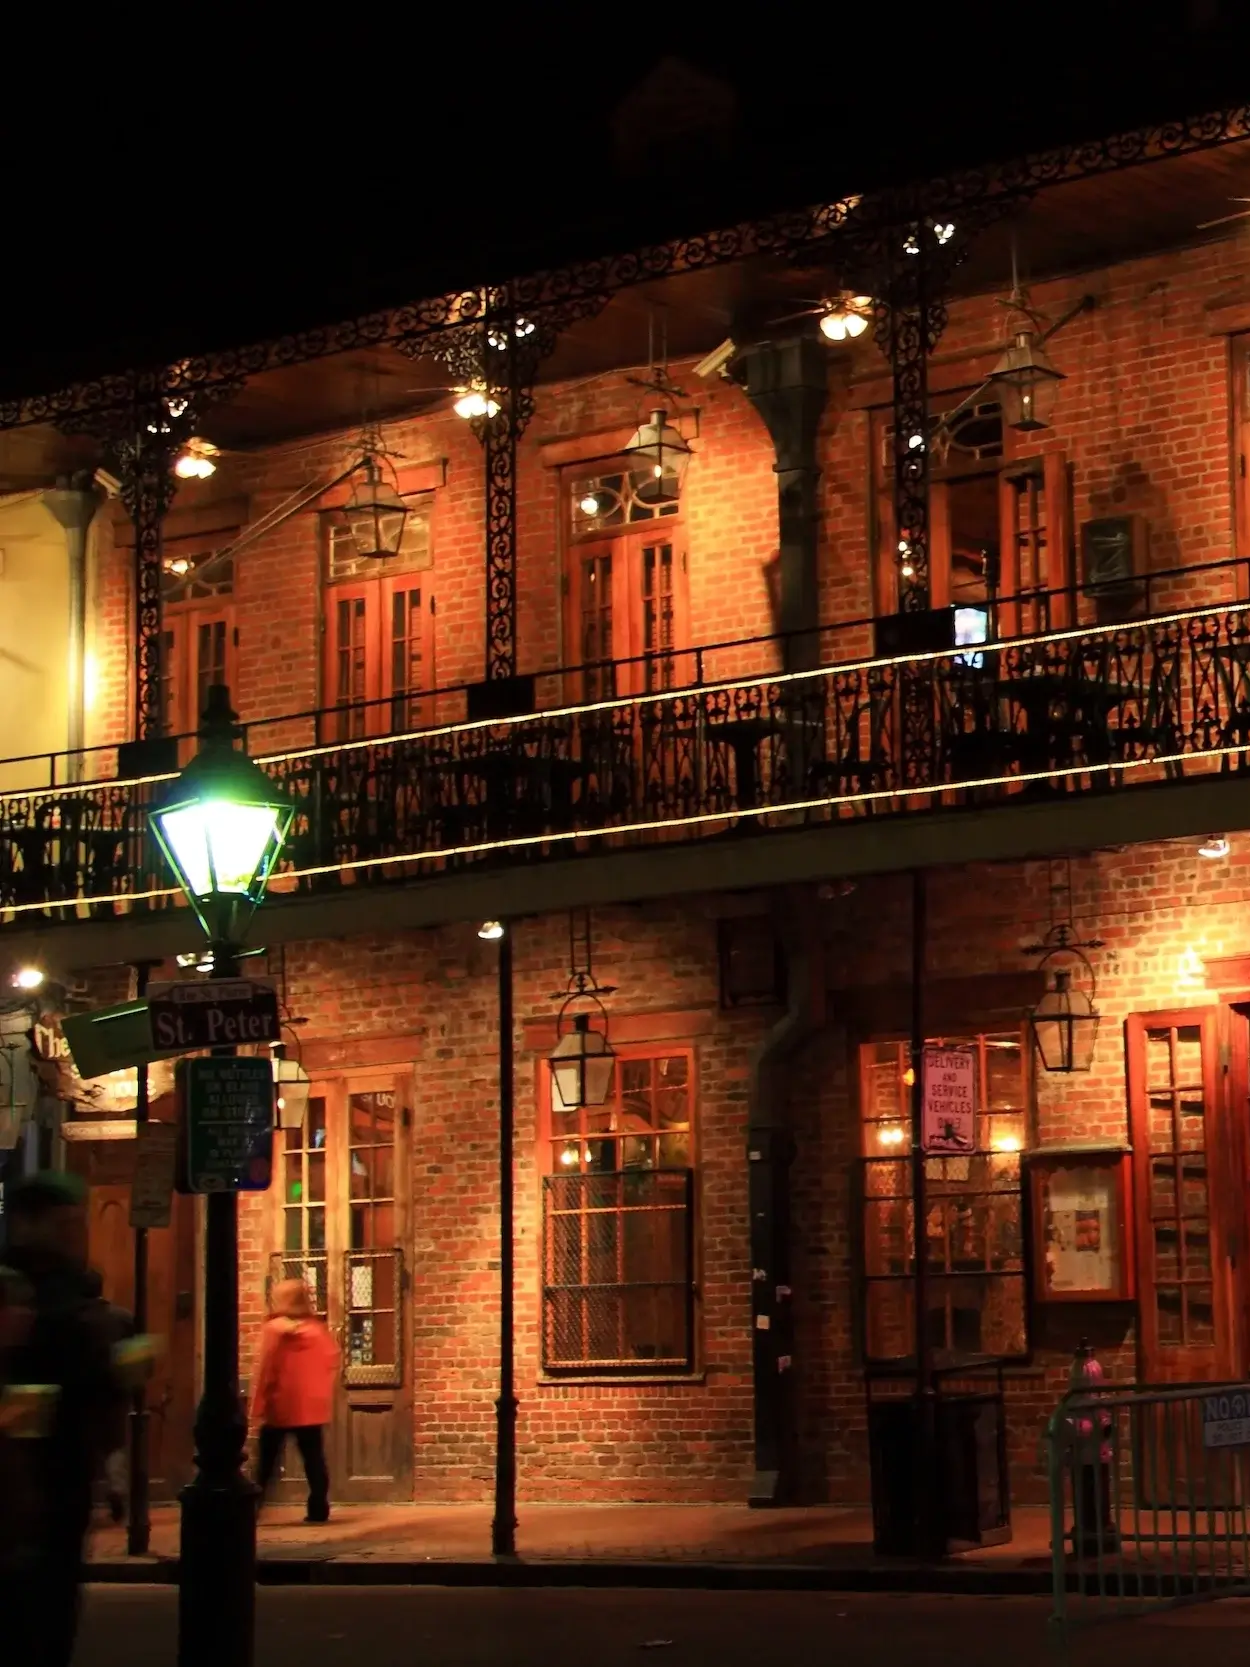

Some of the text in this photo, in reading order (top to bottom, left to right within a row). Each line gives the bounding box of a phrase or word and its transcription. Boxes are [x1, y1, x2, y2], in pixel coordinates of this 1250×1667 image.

[156, 1008, 273, 1046] St. Peter
[927, 1054, 971, 1070] DELIVERY
[942, 1072, 958, 1083] AND
[931, 1084, 968, 1098] SERVICE
[928, 1100, 972, 1114] VEHICLES
